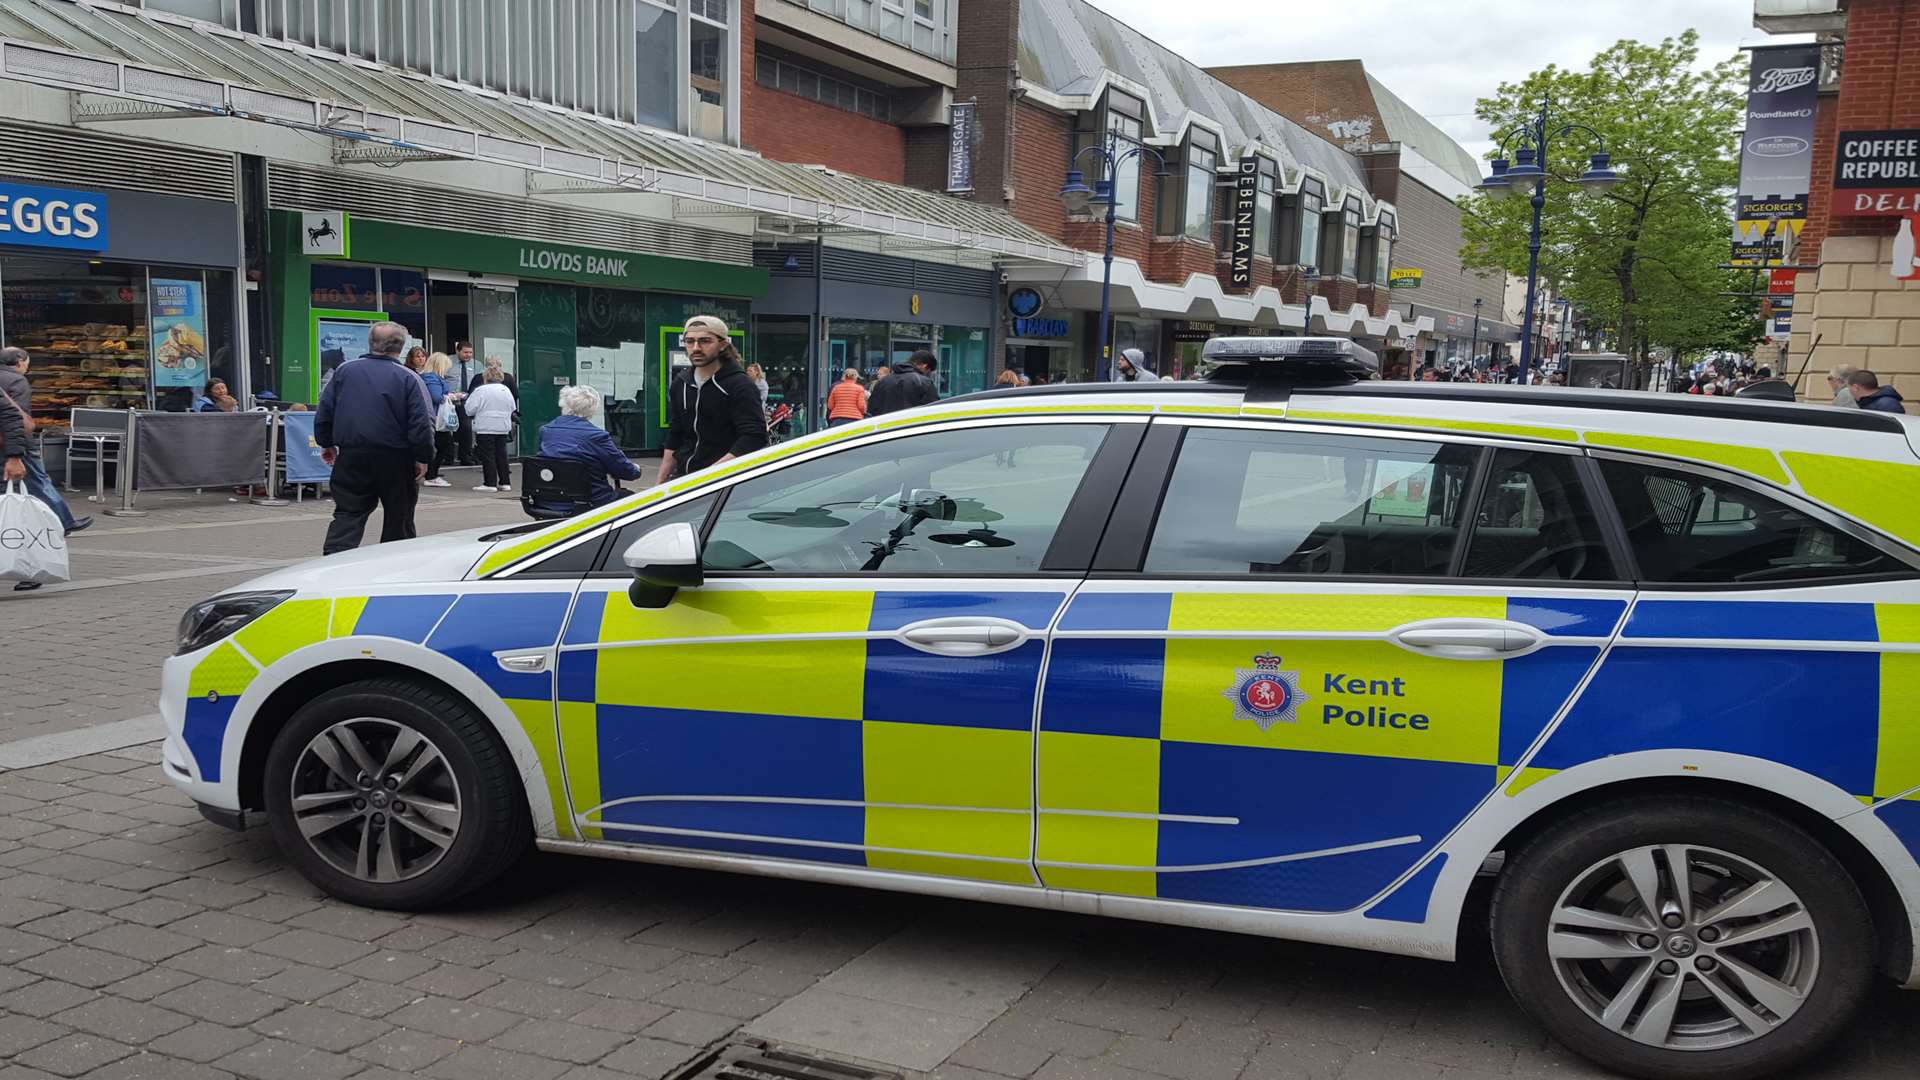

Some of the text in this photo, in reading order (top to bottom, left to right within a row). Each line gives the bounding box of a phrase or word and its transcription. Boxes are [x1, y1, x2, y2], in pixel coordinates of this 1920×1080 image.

[1752, 67, 1816, 93] Boots
[1750, 110, 1799, 119] Poundland
[951, 109, 965, 186] THAMESGATE
[1845, 139, 1918, 158] COFFEE
[1234, 162, 1256, 282] DEBENHAMS
[520, 248, 629, 277] LLOYDS BANK
[1324, 673, 1406, 697] Kent
[1323, 704, 1429, 730] Police
